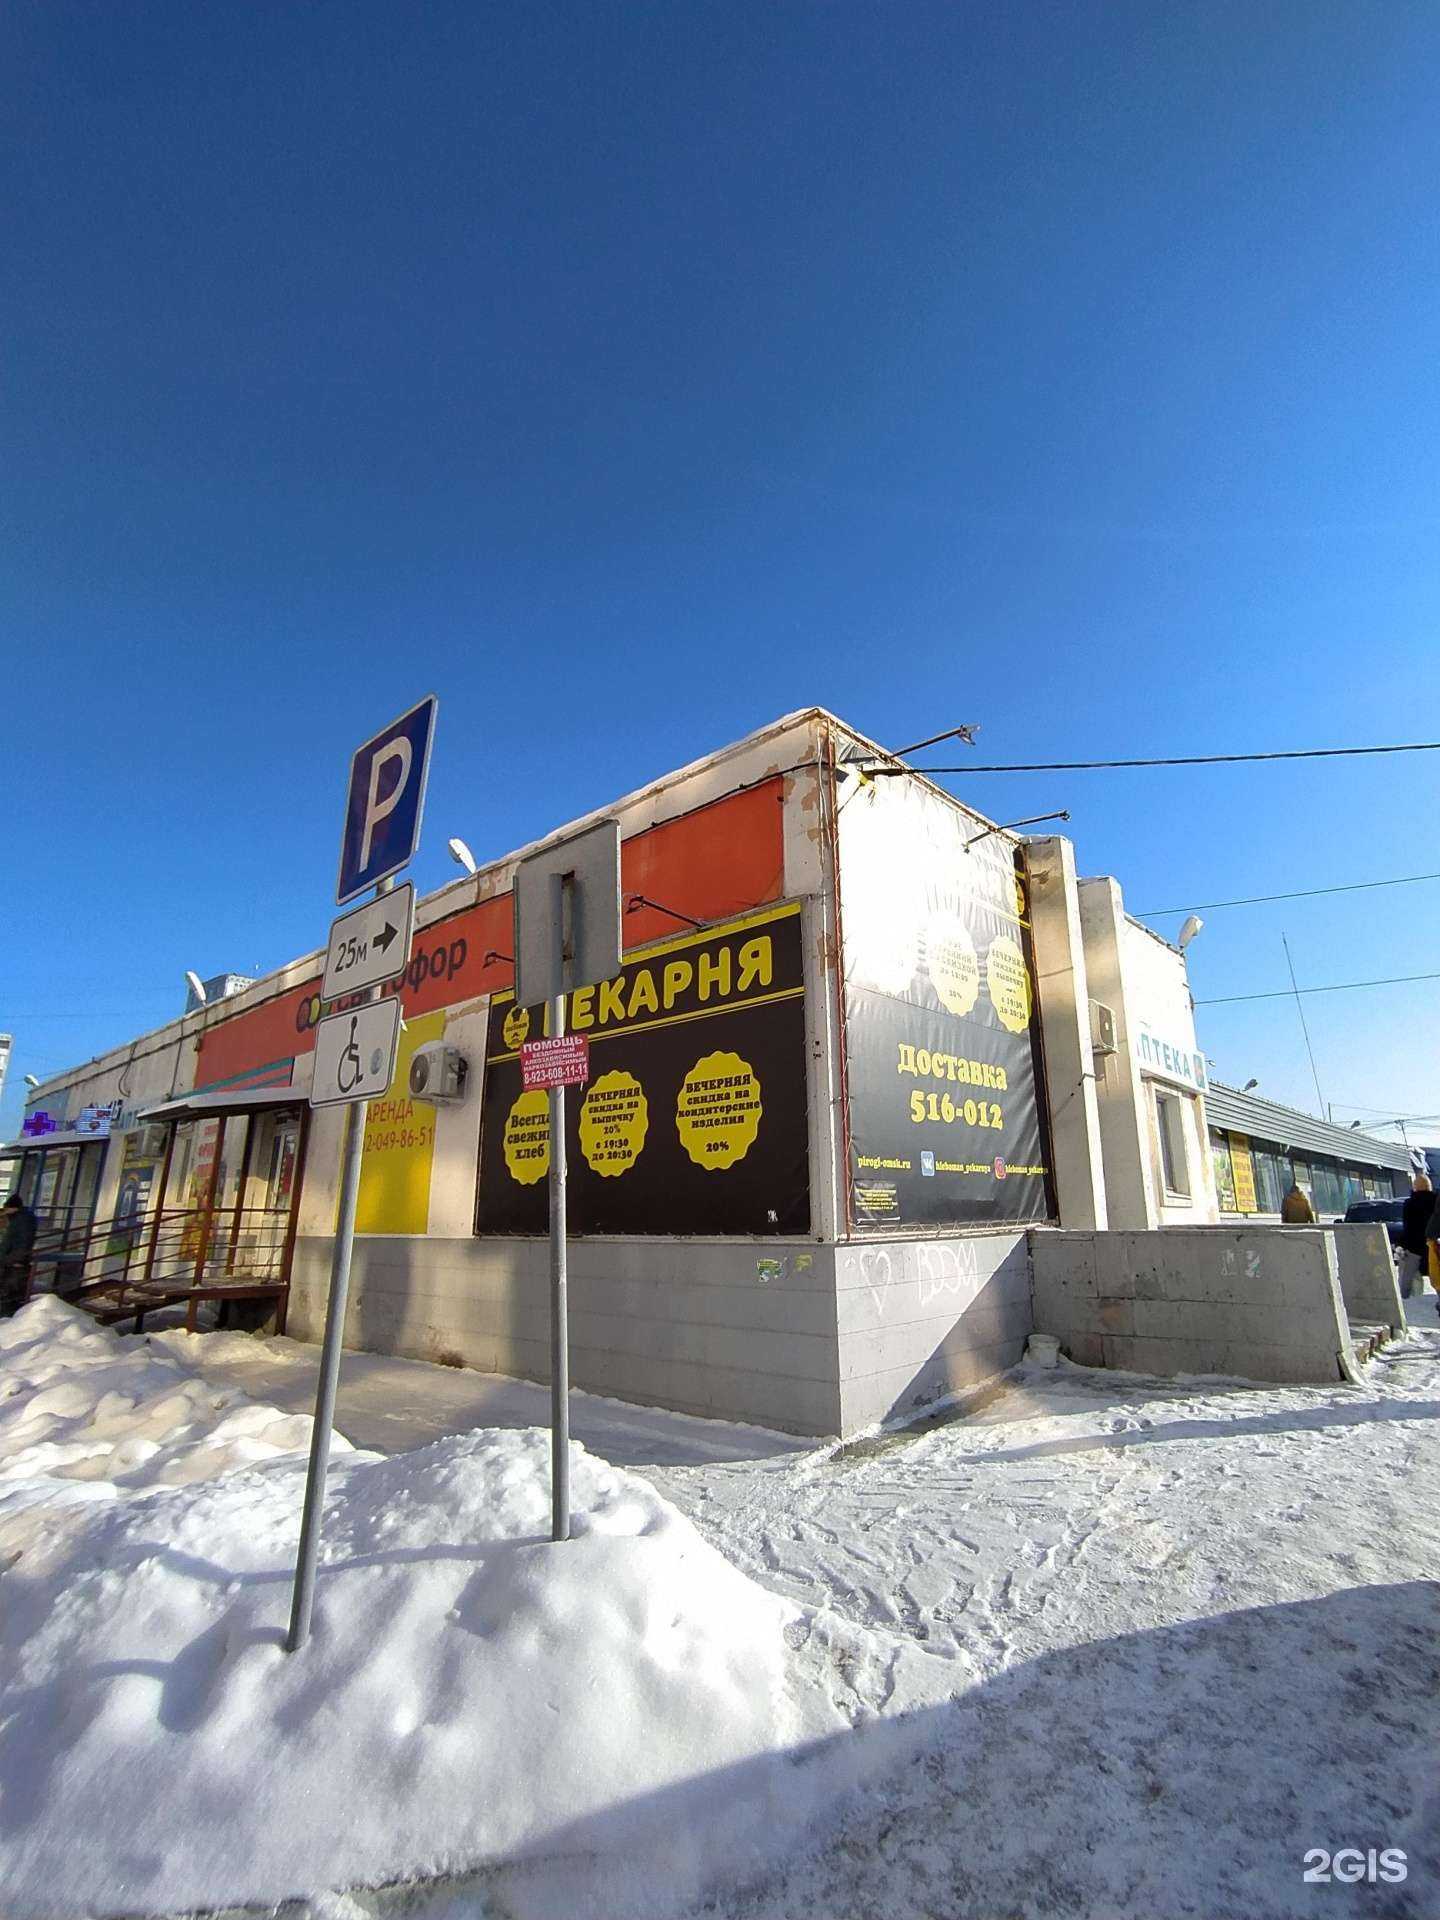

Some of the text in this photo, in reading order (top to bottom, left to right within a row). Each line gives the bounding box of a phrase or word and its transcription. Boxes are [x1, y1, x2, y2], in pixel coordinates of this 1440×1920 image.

[334, 937, 368, 973] 25м
[523, 1036, 584, 1053] ПОМОЩЬ
[1136, 1032, 1192, 1080] ПТЕКА
[524, 1062, 589, 1084] 8-923-608-11-11
[897, 1042, 1008, 1091] Доставка
[685, 1073, 751, 1094] ВЕЧЕРНЯЯ
[587, 1086, 641, 1103] ВЕЧЕРНЯЯ
[687, 1089, 750, 1106] скидка на
[366, 1098, 414, 1125] АРЕНДА
[588, 1100, 640, 1114] скидка на
[678, 1100, 760, 1118] кондитерские
[910, 1089, 1004, 1131] 516-012
[591, 1112, 635, 1125] выпечку
[691, 1115, 745, 1129] изделия
[365, 1125, 434, 1153] 2-049-86-51
[604, 1138, 629, 1149] 19:30
[705, 1141, 730, 1153] 20%
[514, 1142, 545, 1160] хлеб
[592, 1150, 633, 1161] до 20:30
[857, 1156, 911, 1170] pirogi-omsk.ru
